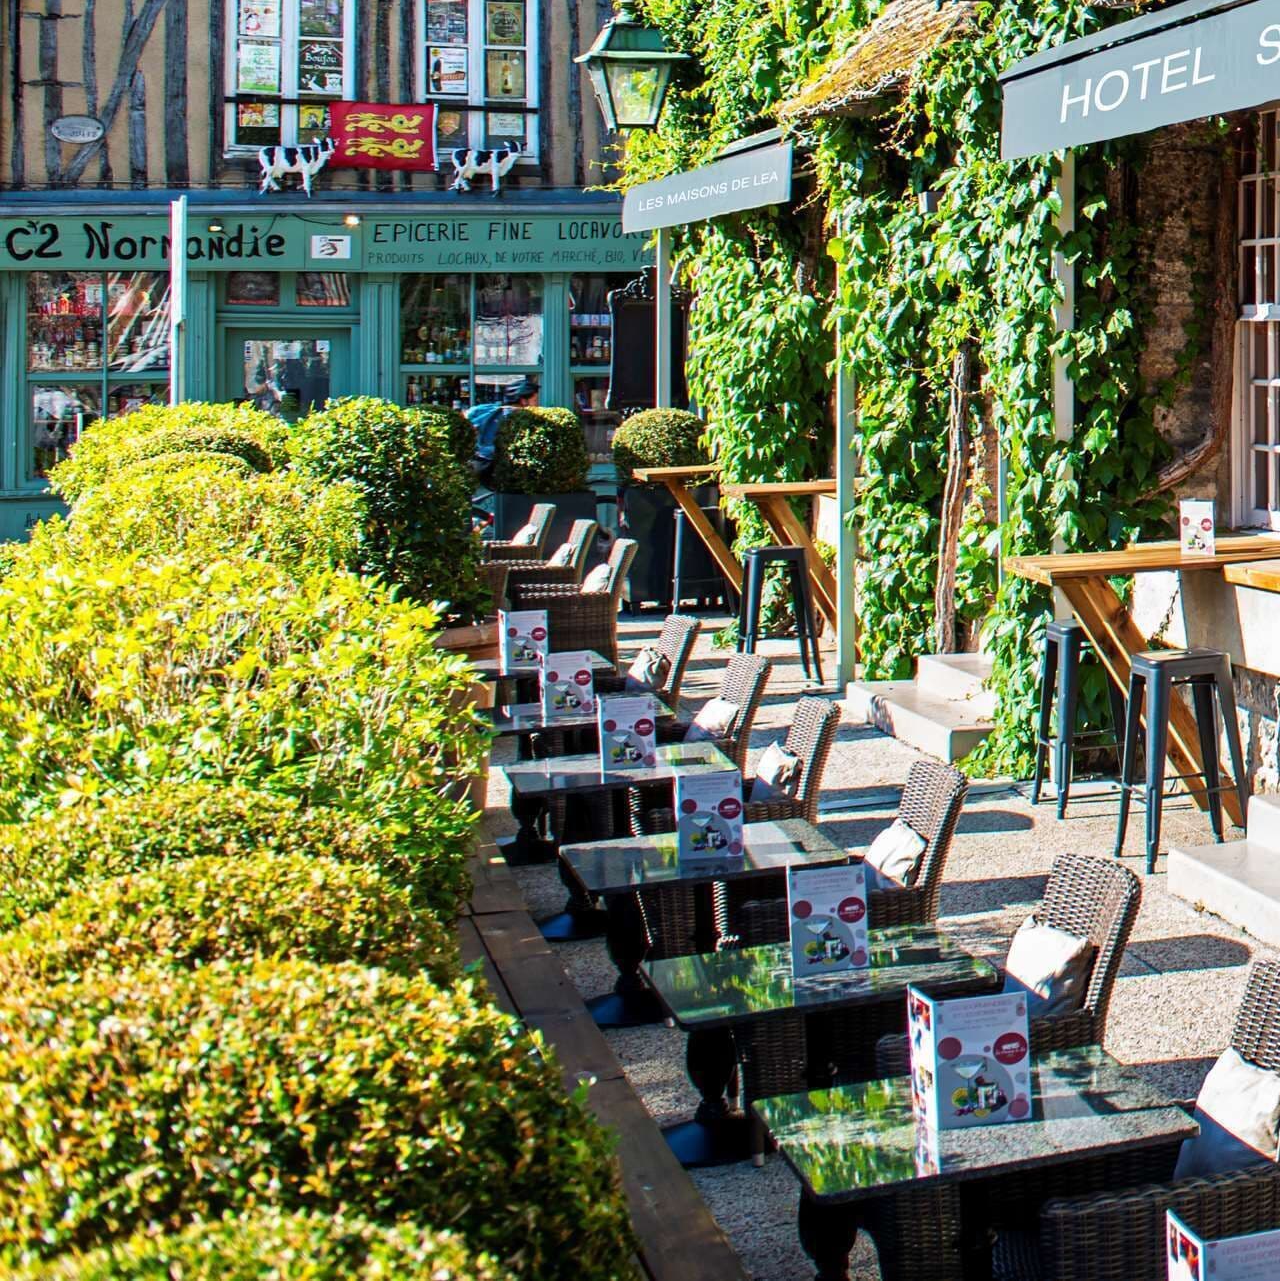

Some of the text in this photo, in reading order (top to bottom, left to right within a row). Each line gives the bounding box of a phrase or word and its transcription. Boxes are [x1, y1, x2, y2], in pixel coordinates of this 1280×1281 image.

[1060, 45, 1216, 124] HOTEL
[639, 171, 779, 212] LES MAISONS DE LEA
[374, 220, 470, 243] EPICERIE
[488, 219, 533, 240] FINE
[368, 252, 425, 264] PRODUITS
[512, 251, 544, 264] VOTRE
